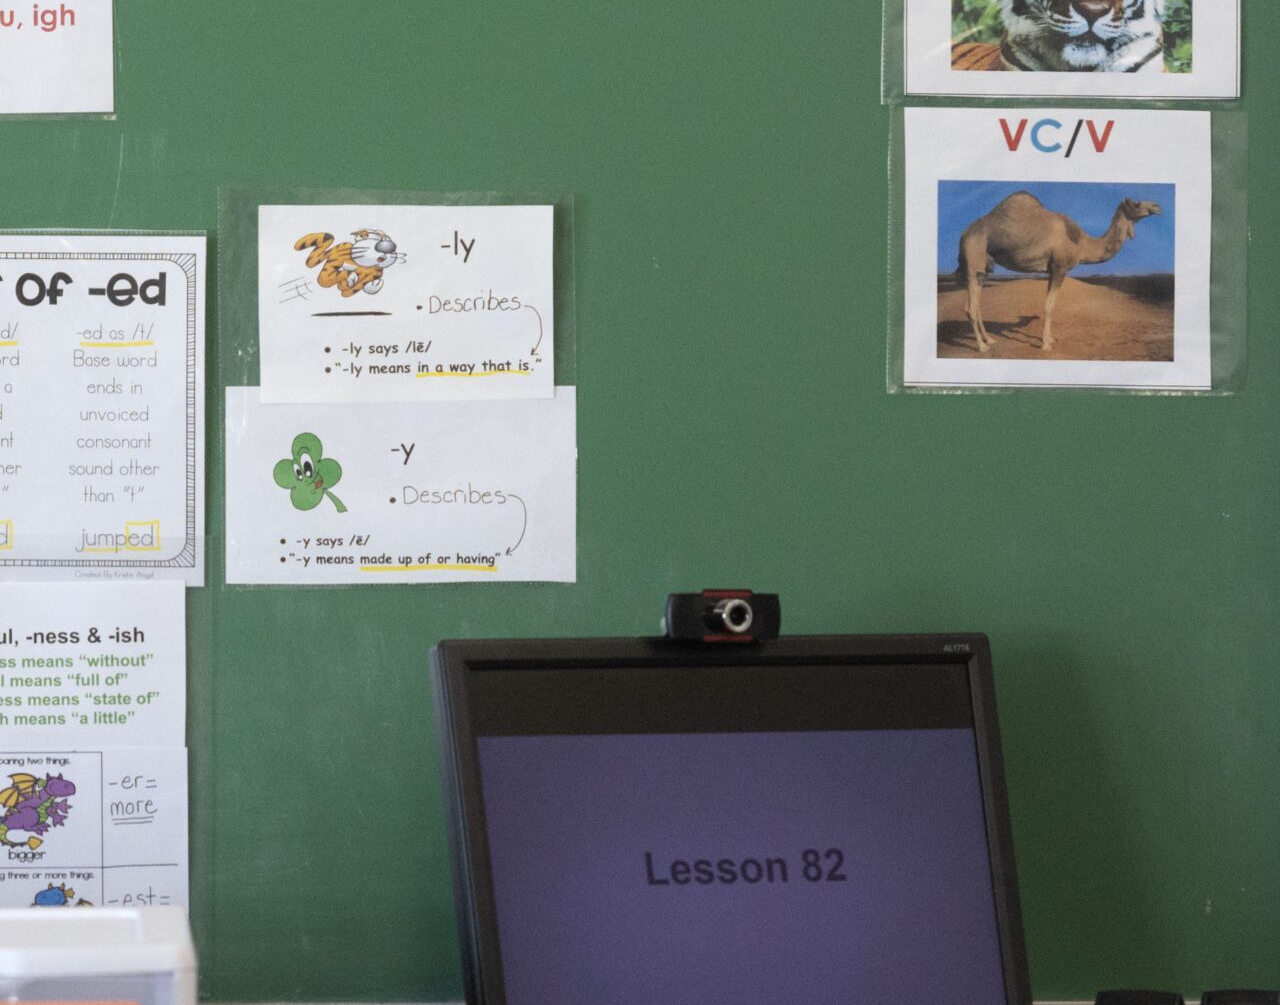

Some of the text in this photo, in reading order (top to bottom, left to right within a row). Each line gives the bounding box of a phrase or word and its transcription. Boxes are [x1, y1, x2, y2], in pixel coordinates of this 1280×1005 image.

[33, 4, 75, 32] igh
[999, 118, 1114, 158] VC/V
[441, 231, 476, 262] -ly
[88, 272, 167, 306] -ed
[429, 290, 521, 314] Describes
[342, 343, 362, 356] -ly
[369, 344, 399, 355] says
[369, 363, 411, 374] means
[418, 362, 429, 373] in
[436, 364, 444, 373] a
[450, 362, 475, 376] way
[482, 360, 511, 372] that
[79, 407, 149, 422] unvoiced
[76, 435, 152, 449] consonant
[391, 442, 415, 465] -y
[403, 484, 507, 506] Describes
[75, 523, 154, 552] jumped
[296, 537, 311, 549] -y
[316, 536, 343, 548] says
[316, 554, 354, 565] means
[361, 553, 392, 565] made
[398, 555, 412, 566] up
[419, 553, 432, 565] of
[437, 555, 451, 565] or
[26, 629, 80, 644] -ness
[87, 628, 101, 643] &
[108, 627, 145, 642] -ish
[21, 656, 73, 667] means
[10, 675, 62, 687] means
[28, 694, 79, 706] means
[14, 713, 66, 725] means
[110, 798, 157, 816] more
[8, 849, 46, 862] bigger
[644, 848, 847, 886] Lesson 82
